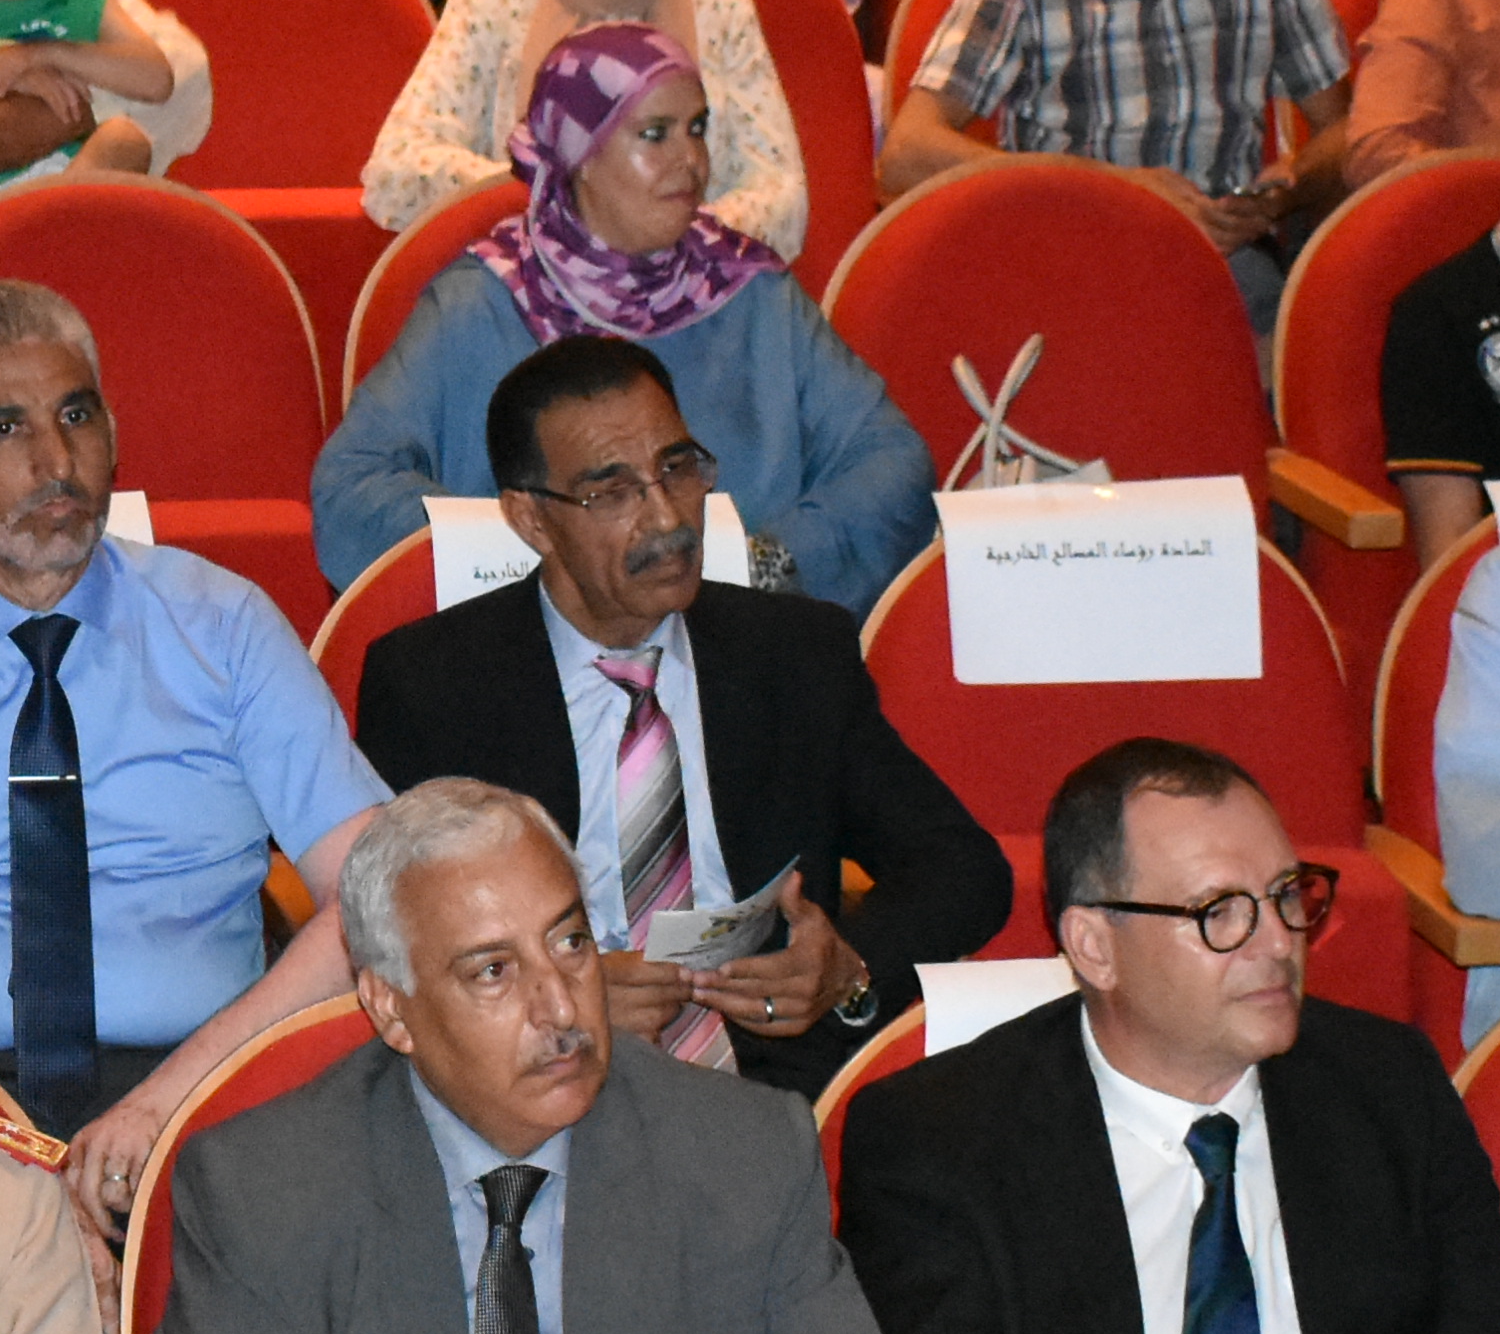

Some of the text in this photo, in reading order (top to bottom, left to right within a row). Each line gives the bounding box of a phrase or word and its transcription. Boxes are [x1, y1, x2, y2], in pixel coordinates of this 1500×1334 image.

[986, 539, 1213, 566] السادة رؤساء المصالح الخارجية
